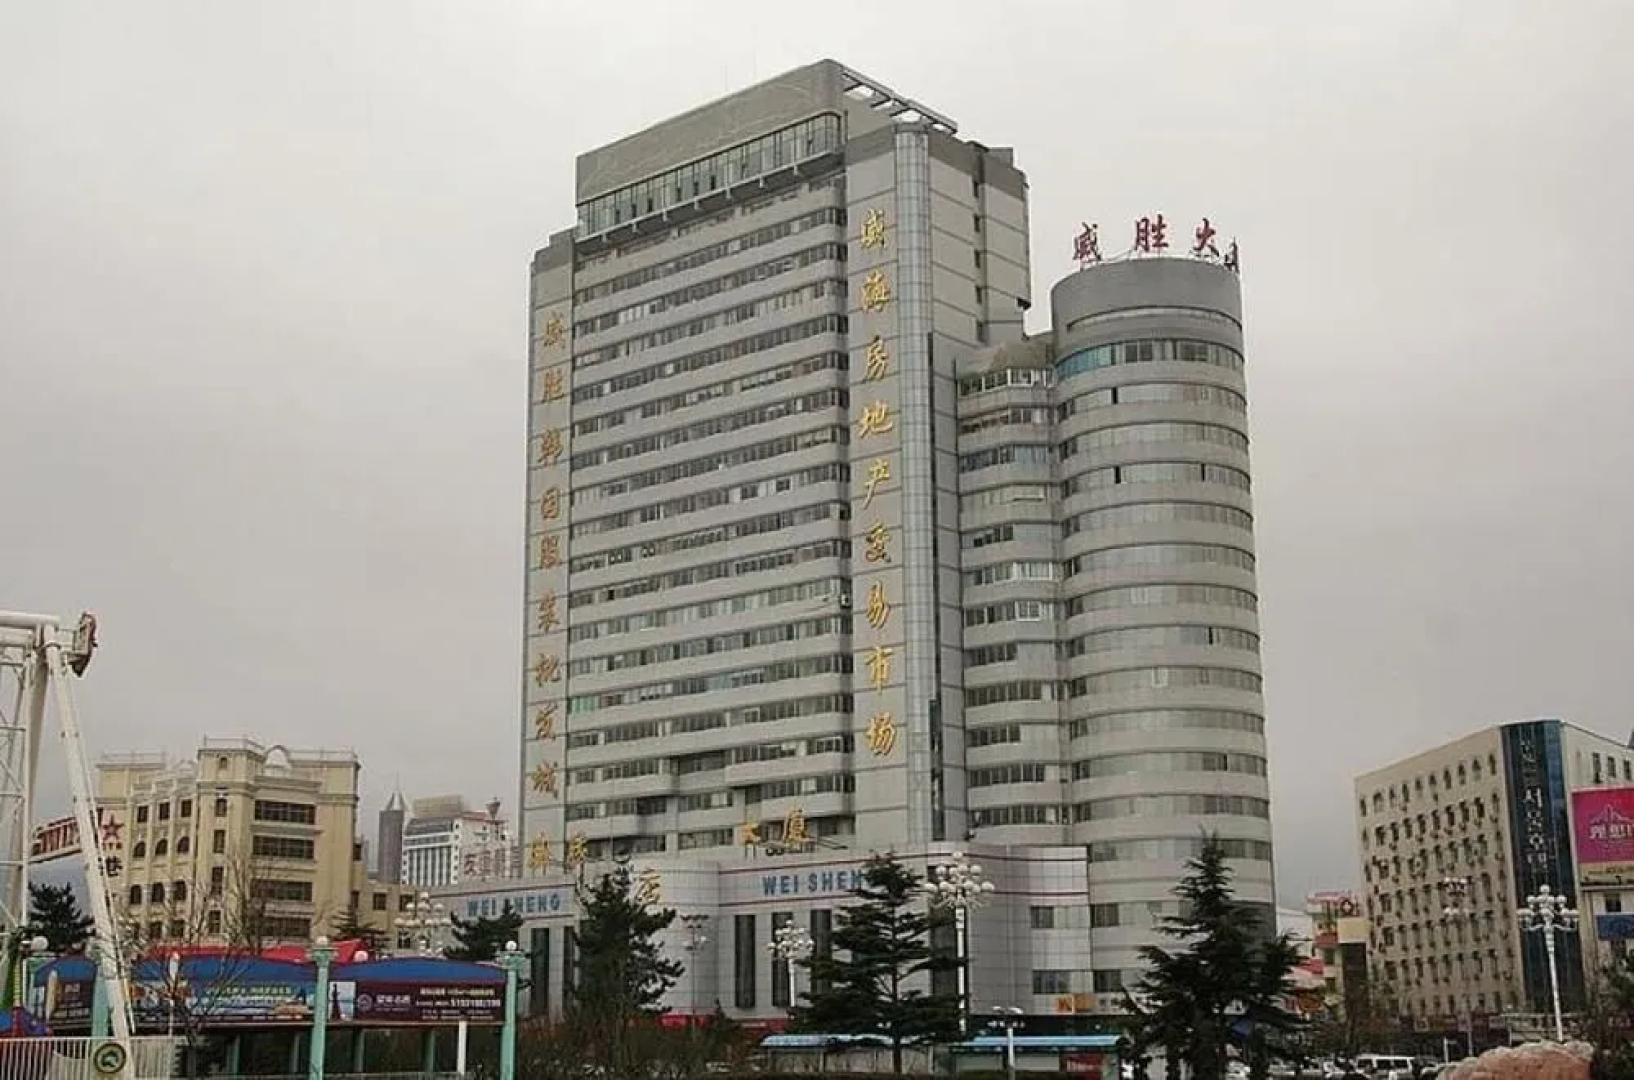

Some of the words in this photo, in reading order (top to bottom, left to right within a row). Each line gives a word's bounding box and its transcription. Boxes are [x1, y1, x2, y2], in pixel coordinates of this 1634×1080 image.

[1072, 213, 1240, 274] 威胜大
[860, 198, 896, 756] 威海房地产交易市场
[762, 874, 799, 895] WEI
[808, 869, 864, 892] SHEN
[467, 896, 497, 917] WEI
[502, 893, 561, 915] HENG
